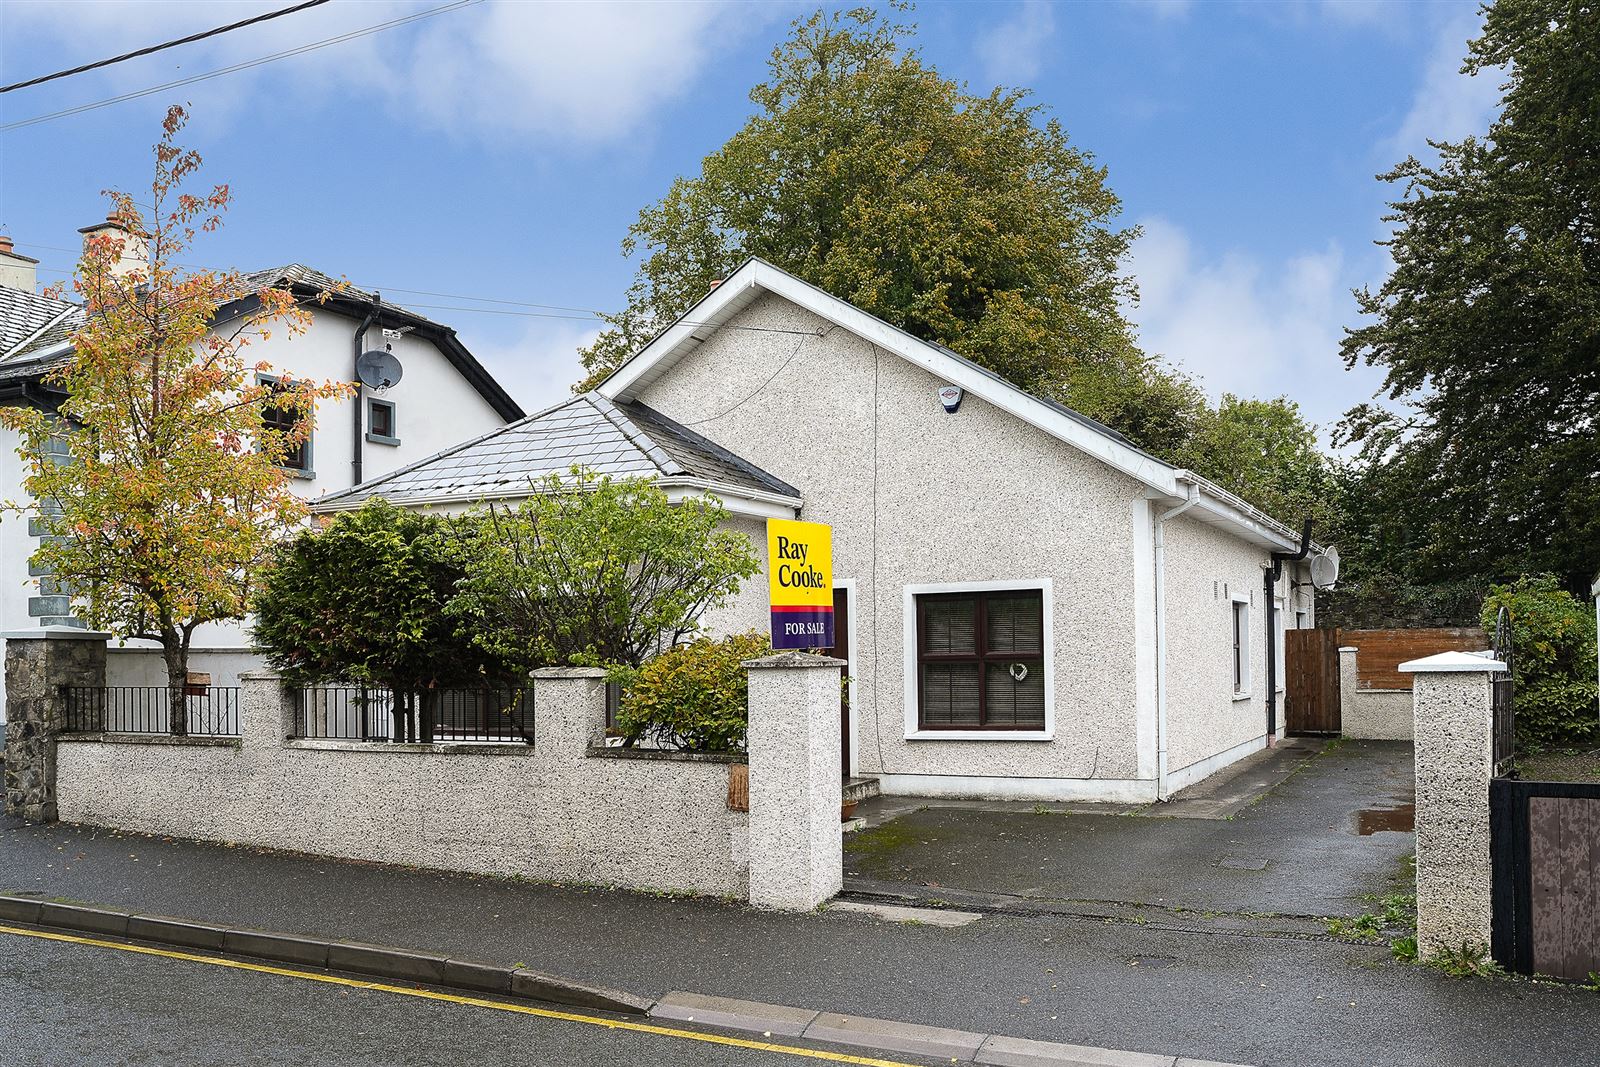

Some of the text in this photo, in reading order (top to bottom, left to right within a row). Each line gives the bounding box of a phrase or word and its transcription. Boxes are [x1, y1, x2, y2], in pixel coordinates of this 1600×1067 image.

[777, 536, 808, 567] Ray
[778, 564, 826, 589] Cooke.
[785, 622, 825, 635] FOR SALE
